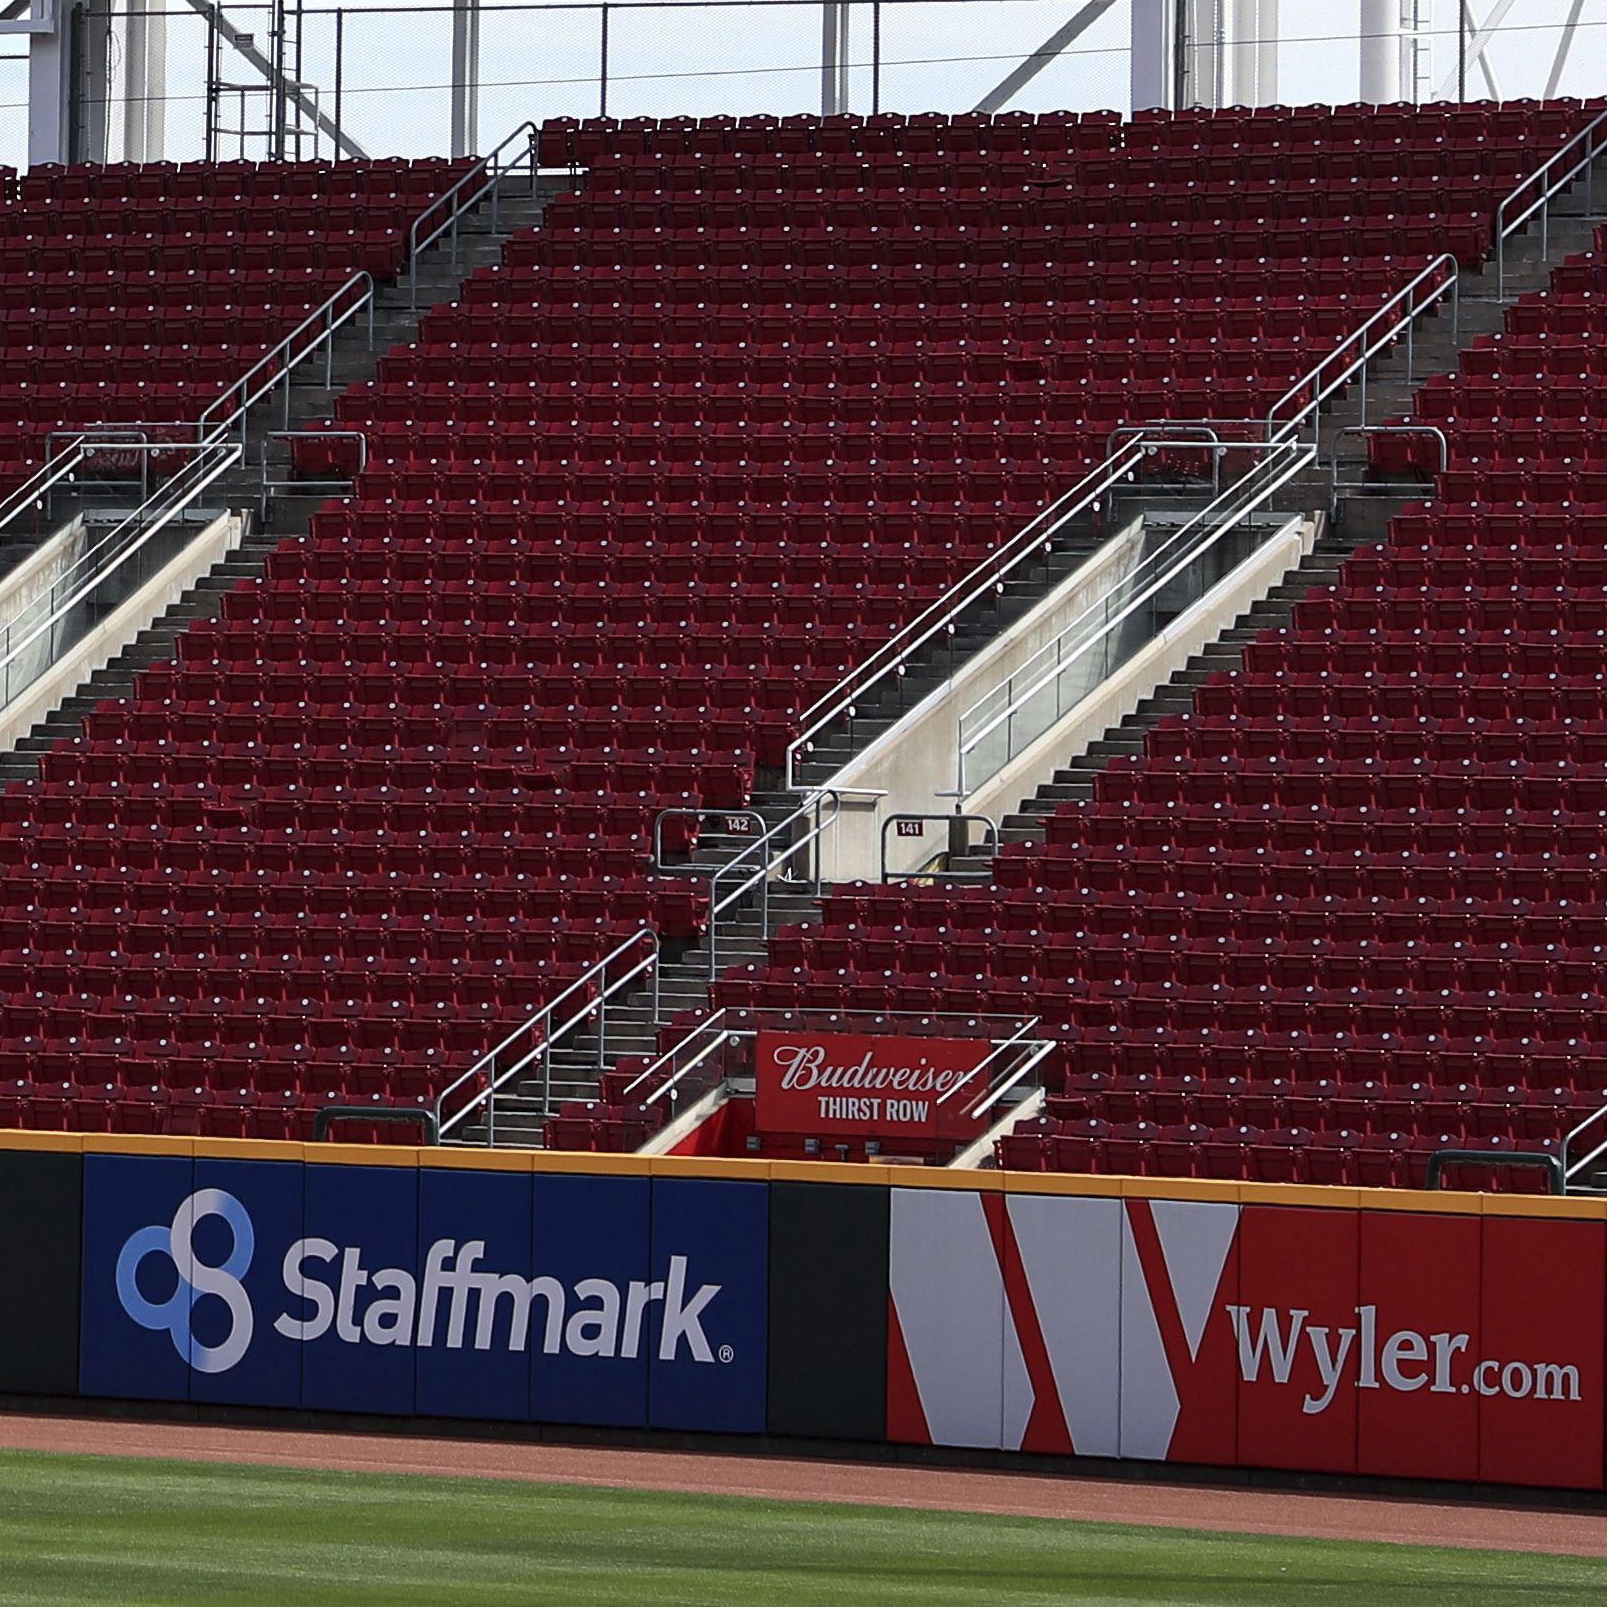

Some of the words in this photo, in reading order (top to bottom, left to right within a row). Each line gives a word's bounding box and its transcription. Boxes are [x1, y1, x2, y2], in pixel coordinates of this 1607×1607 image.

[728, 818, 748, 831] 142
[900, 822, 919, 834] 141
[774, 1046, 973, 1092] Budweiser
[818, 1096, 882, 1120] THIRST
[886, 1098, 929, 1122] ROW
[273, 1237, 723, 1364] Staffmark
[1226, 1305, 1581, 1414] Wyler.com
